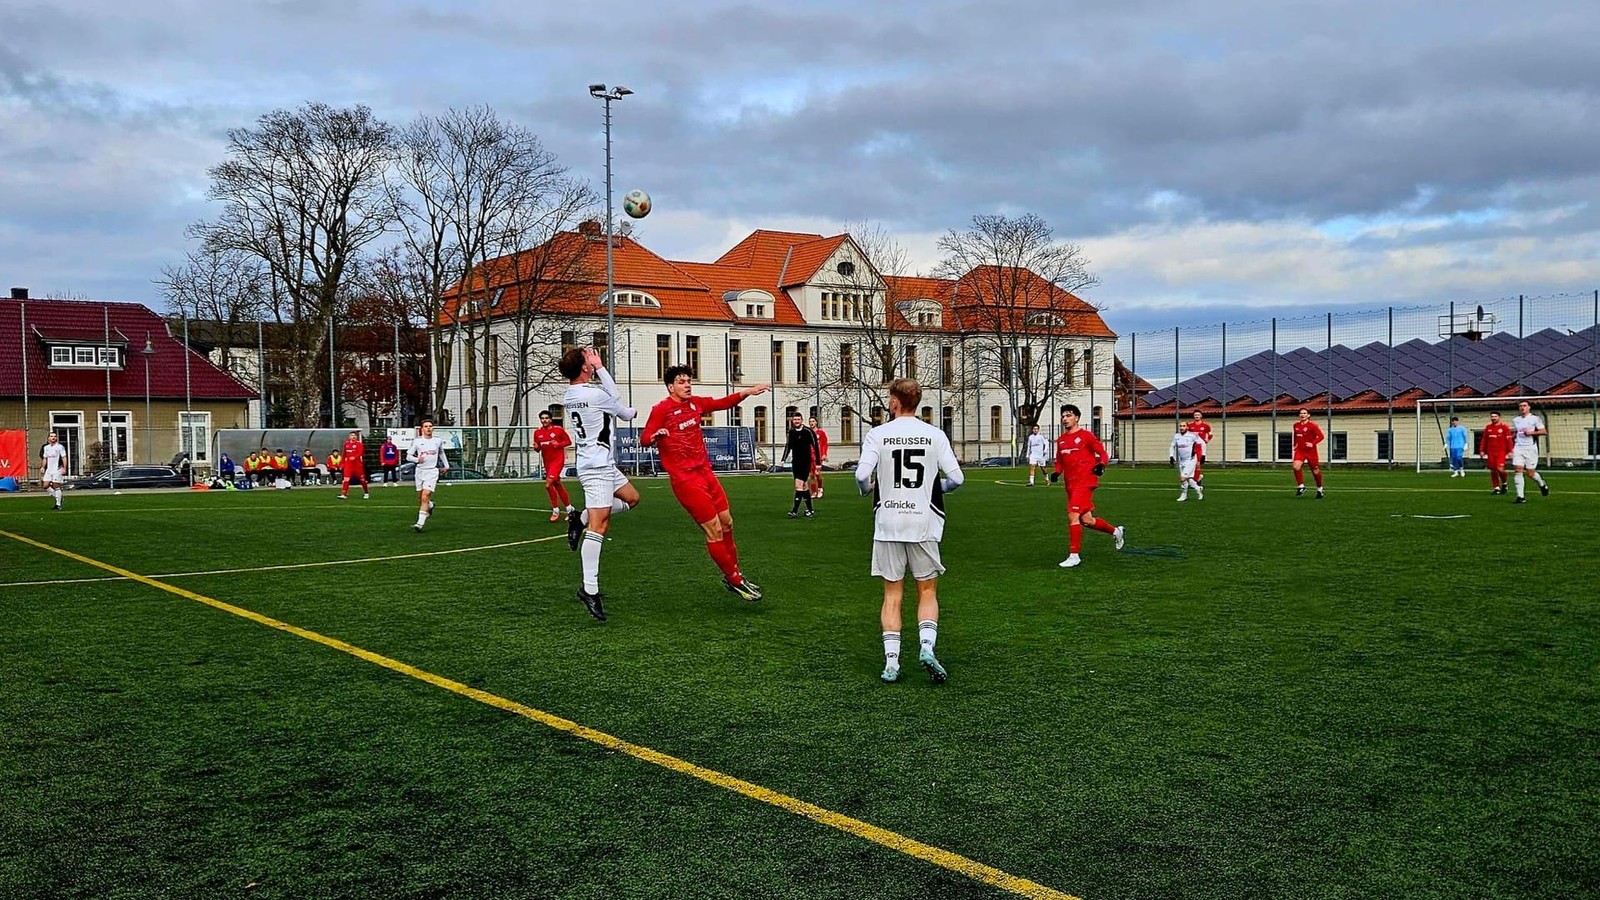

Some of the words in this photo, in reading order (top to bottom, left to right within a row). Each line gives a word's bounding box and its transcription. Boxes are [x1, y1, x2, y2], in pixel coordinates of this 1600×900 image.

[571, 411, 587, 439] 3
[621, 436, 633, 444] Wir
[883, 437, 932, 446] PREUSSEN
[621, 446, 629, 454] in
[631, 446, 643, 454] Bad
[645, 446, 660, 455] Lang
[892, 448, 926, 489] 15
[884, 500, 916, 510] Glinicke
